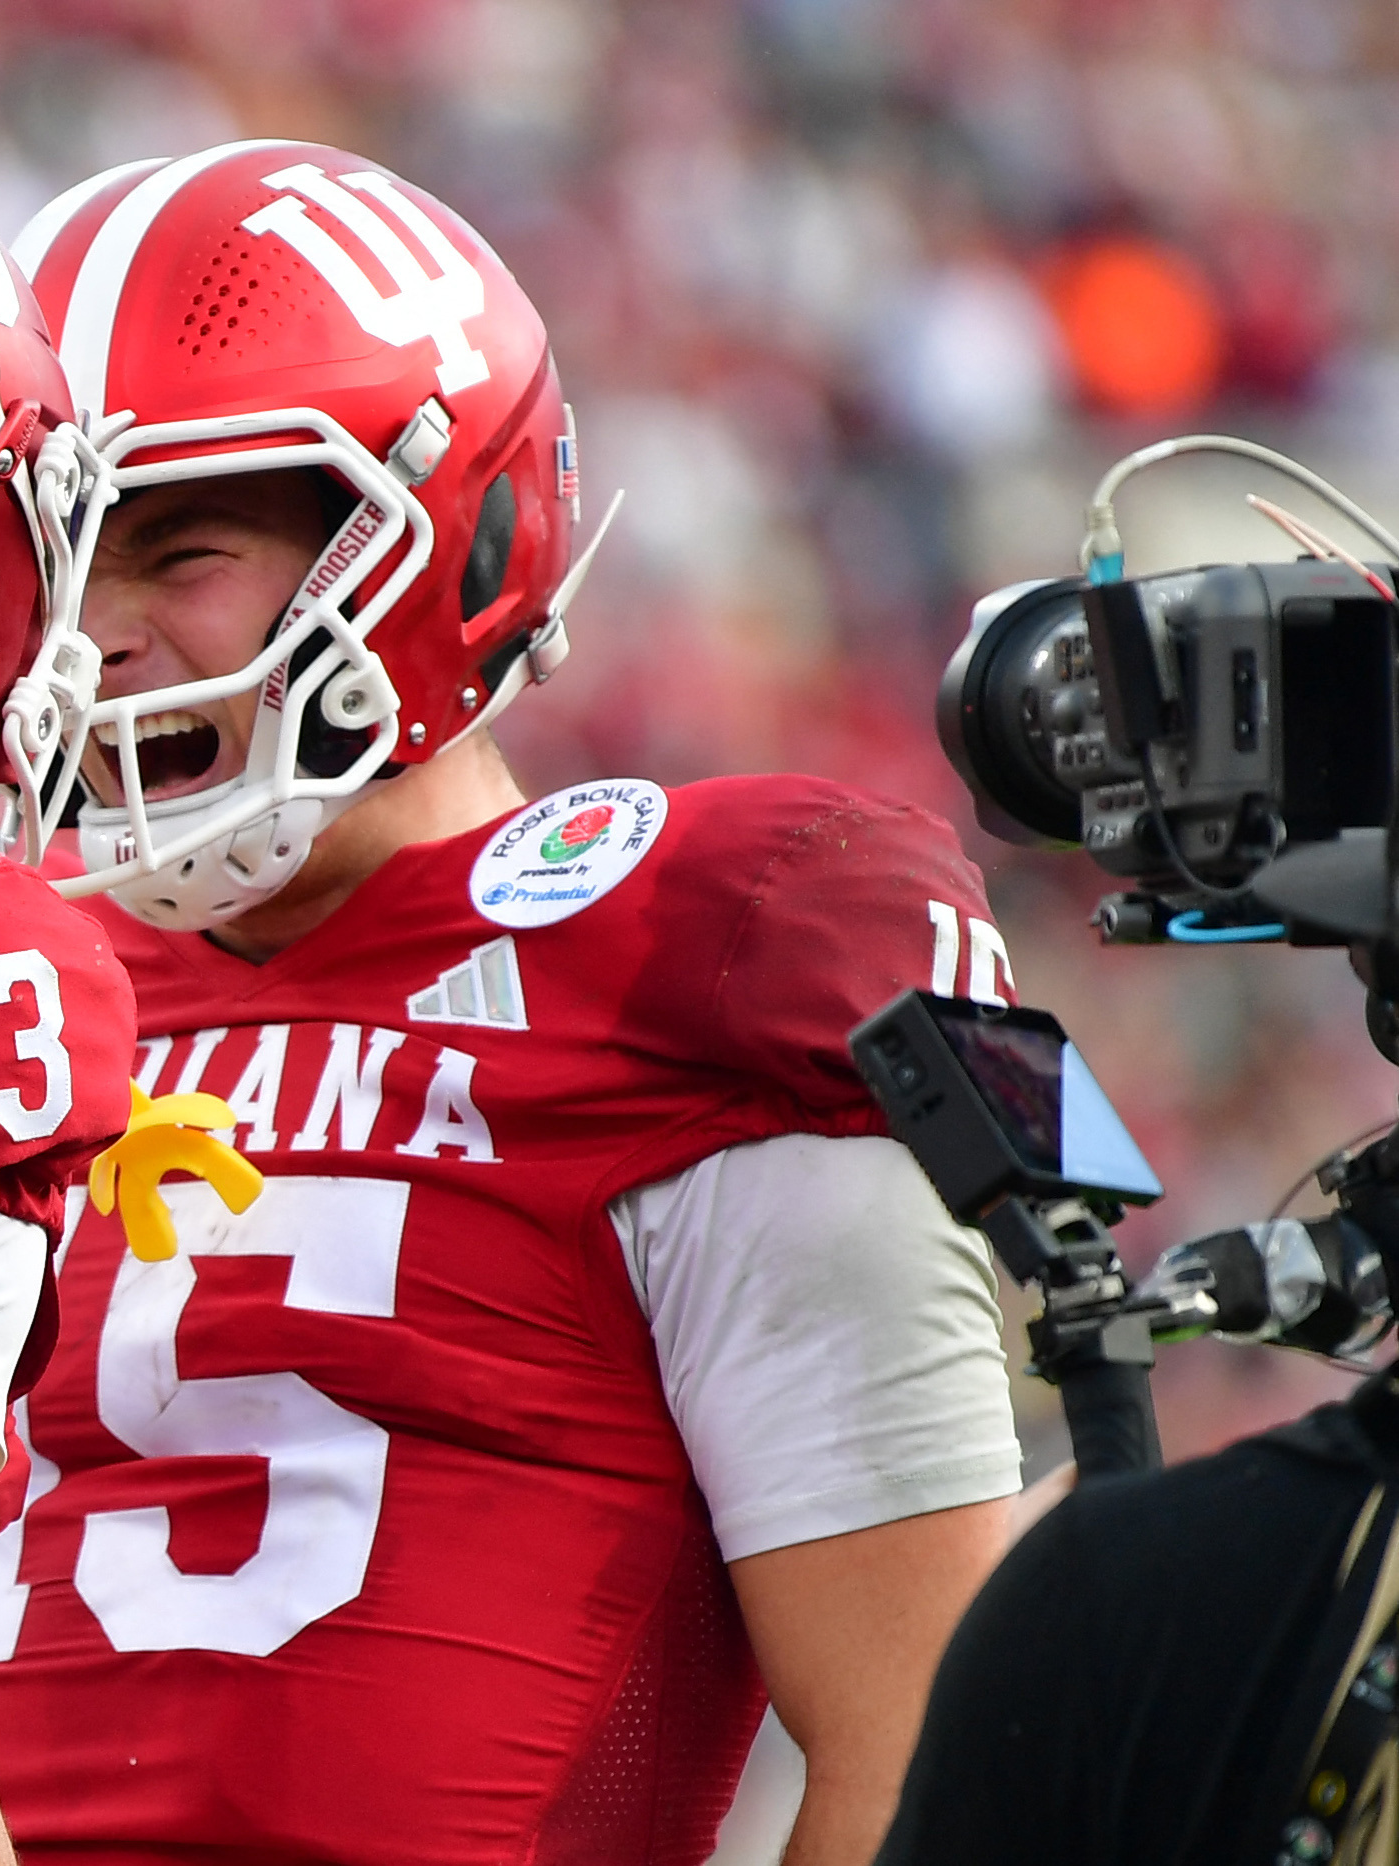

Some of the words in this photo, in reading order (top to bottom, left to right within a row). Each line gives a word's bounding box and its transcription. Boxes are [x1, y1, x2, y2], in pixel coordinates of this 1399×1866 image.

[491, 802, 561, 858] ROSE
[568, 786, 639, 808] BOWL
[621, 796, 655, 852] GAME
[511, 884, 597, 902] Prudential
